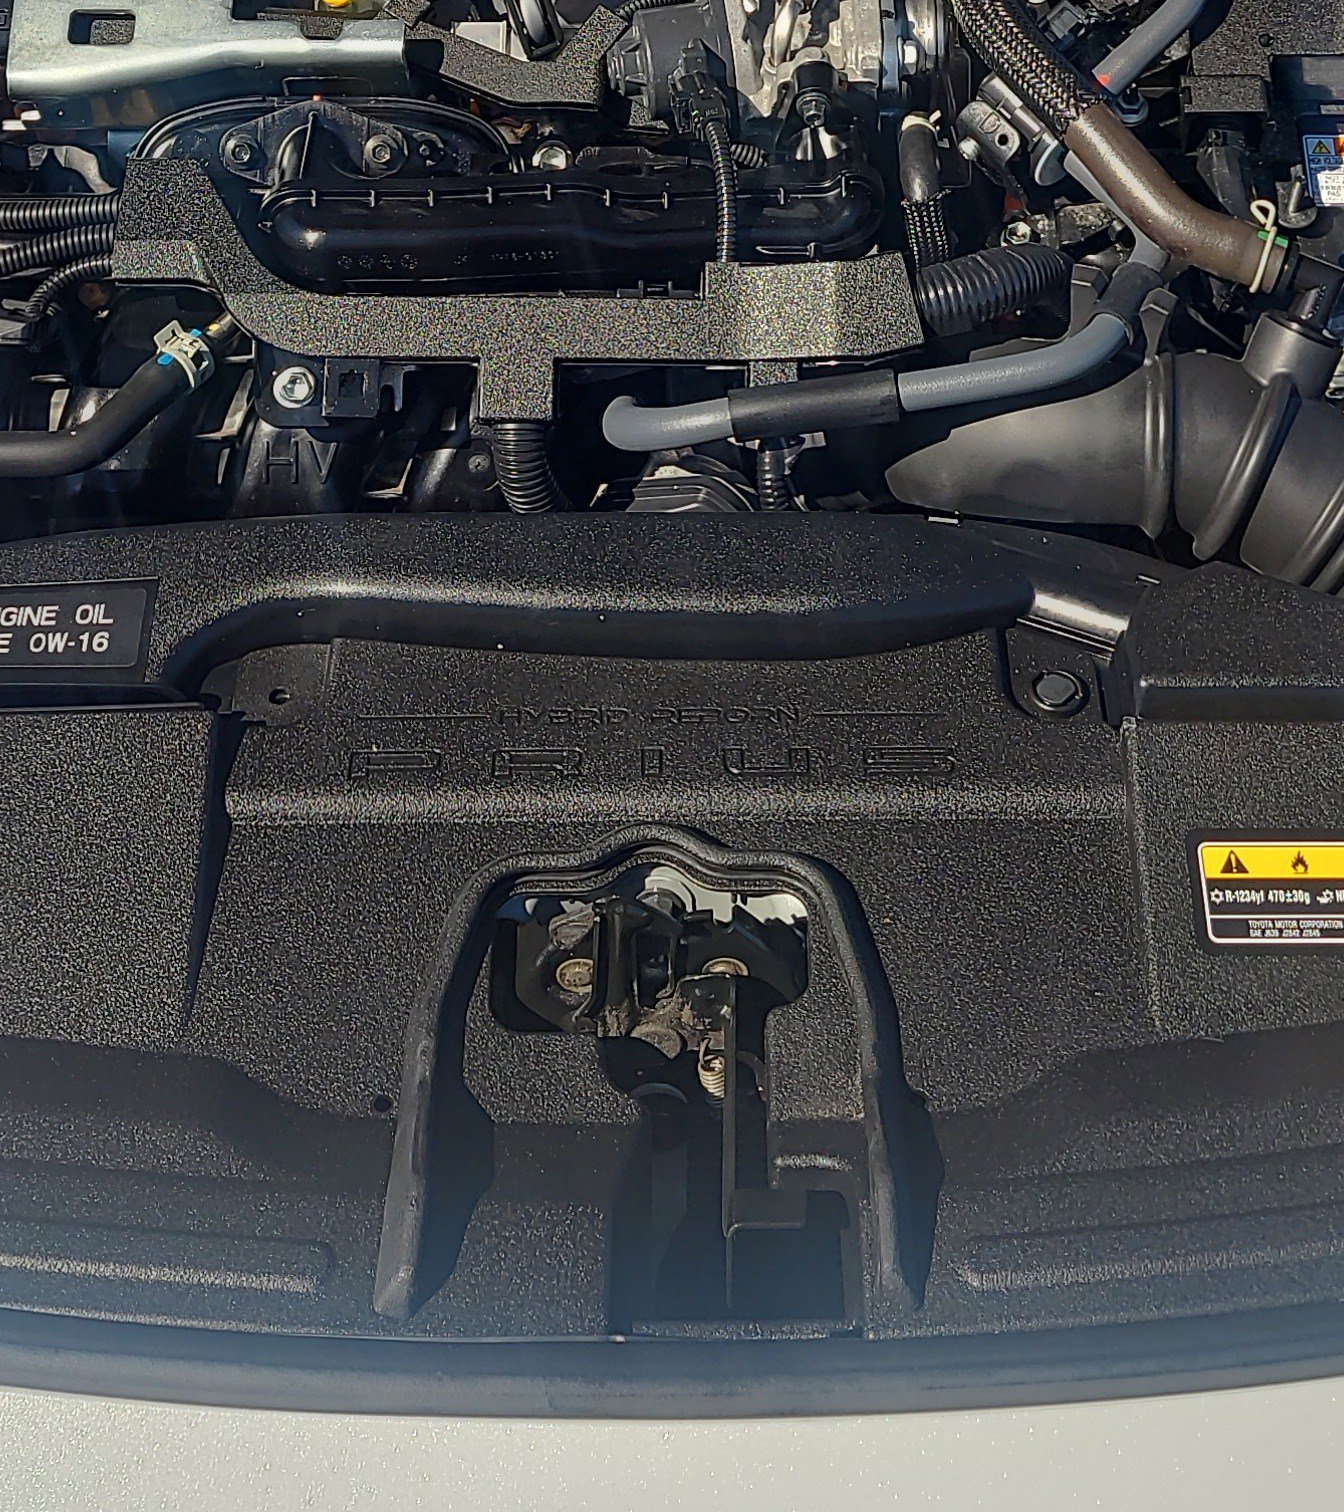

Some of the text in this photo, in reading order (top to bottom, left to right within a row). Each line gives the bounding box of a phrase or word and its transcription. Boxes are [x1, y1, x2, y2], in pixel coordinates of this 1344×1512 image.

[262, 438, 339, 484] HV
[75, 603, 114, 625] OIL
[29, 631, 110, 653] 0W-16
[499, 705, 802, 726] HYBRID REBORN
[348, 745, 956, 780] PRIUS
[1225, 889, 1265, 905] R-1234yf
[1268, 889, 1311, 905] 470±30g
[1248, 919, 1344, 930] TOYOTA MOTOR CORPORATION
